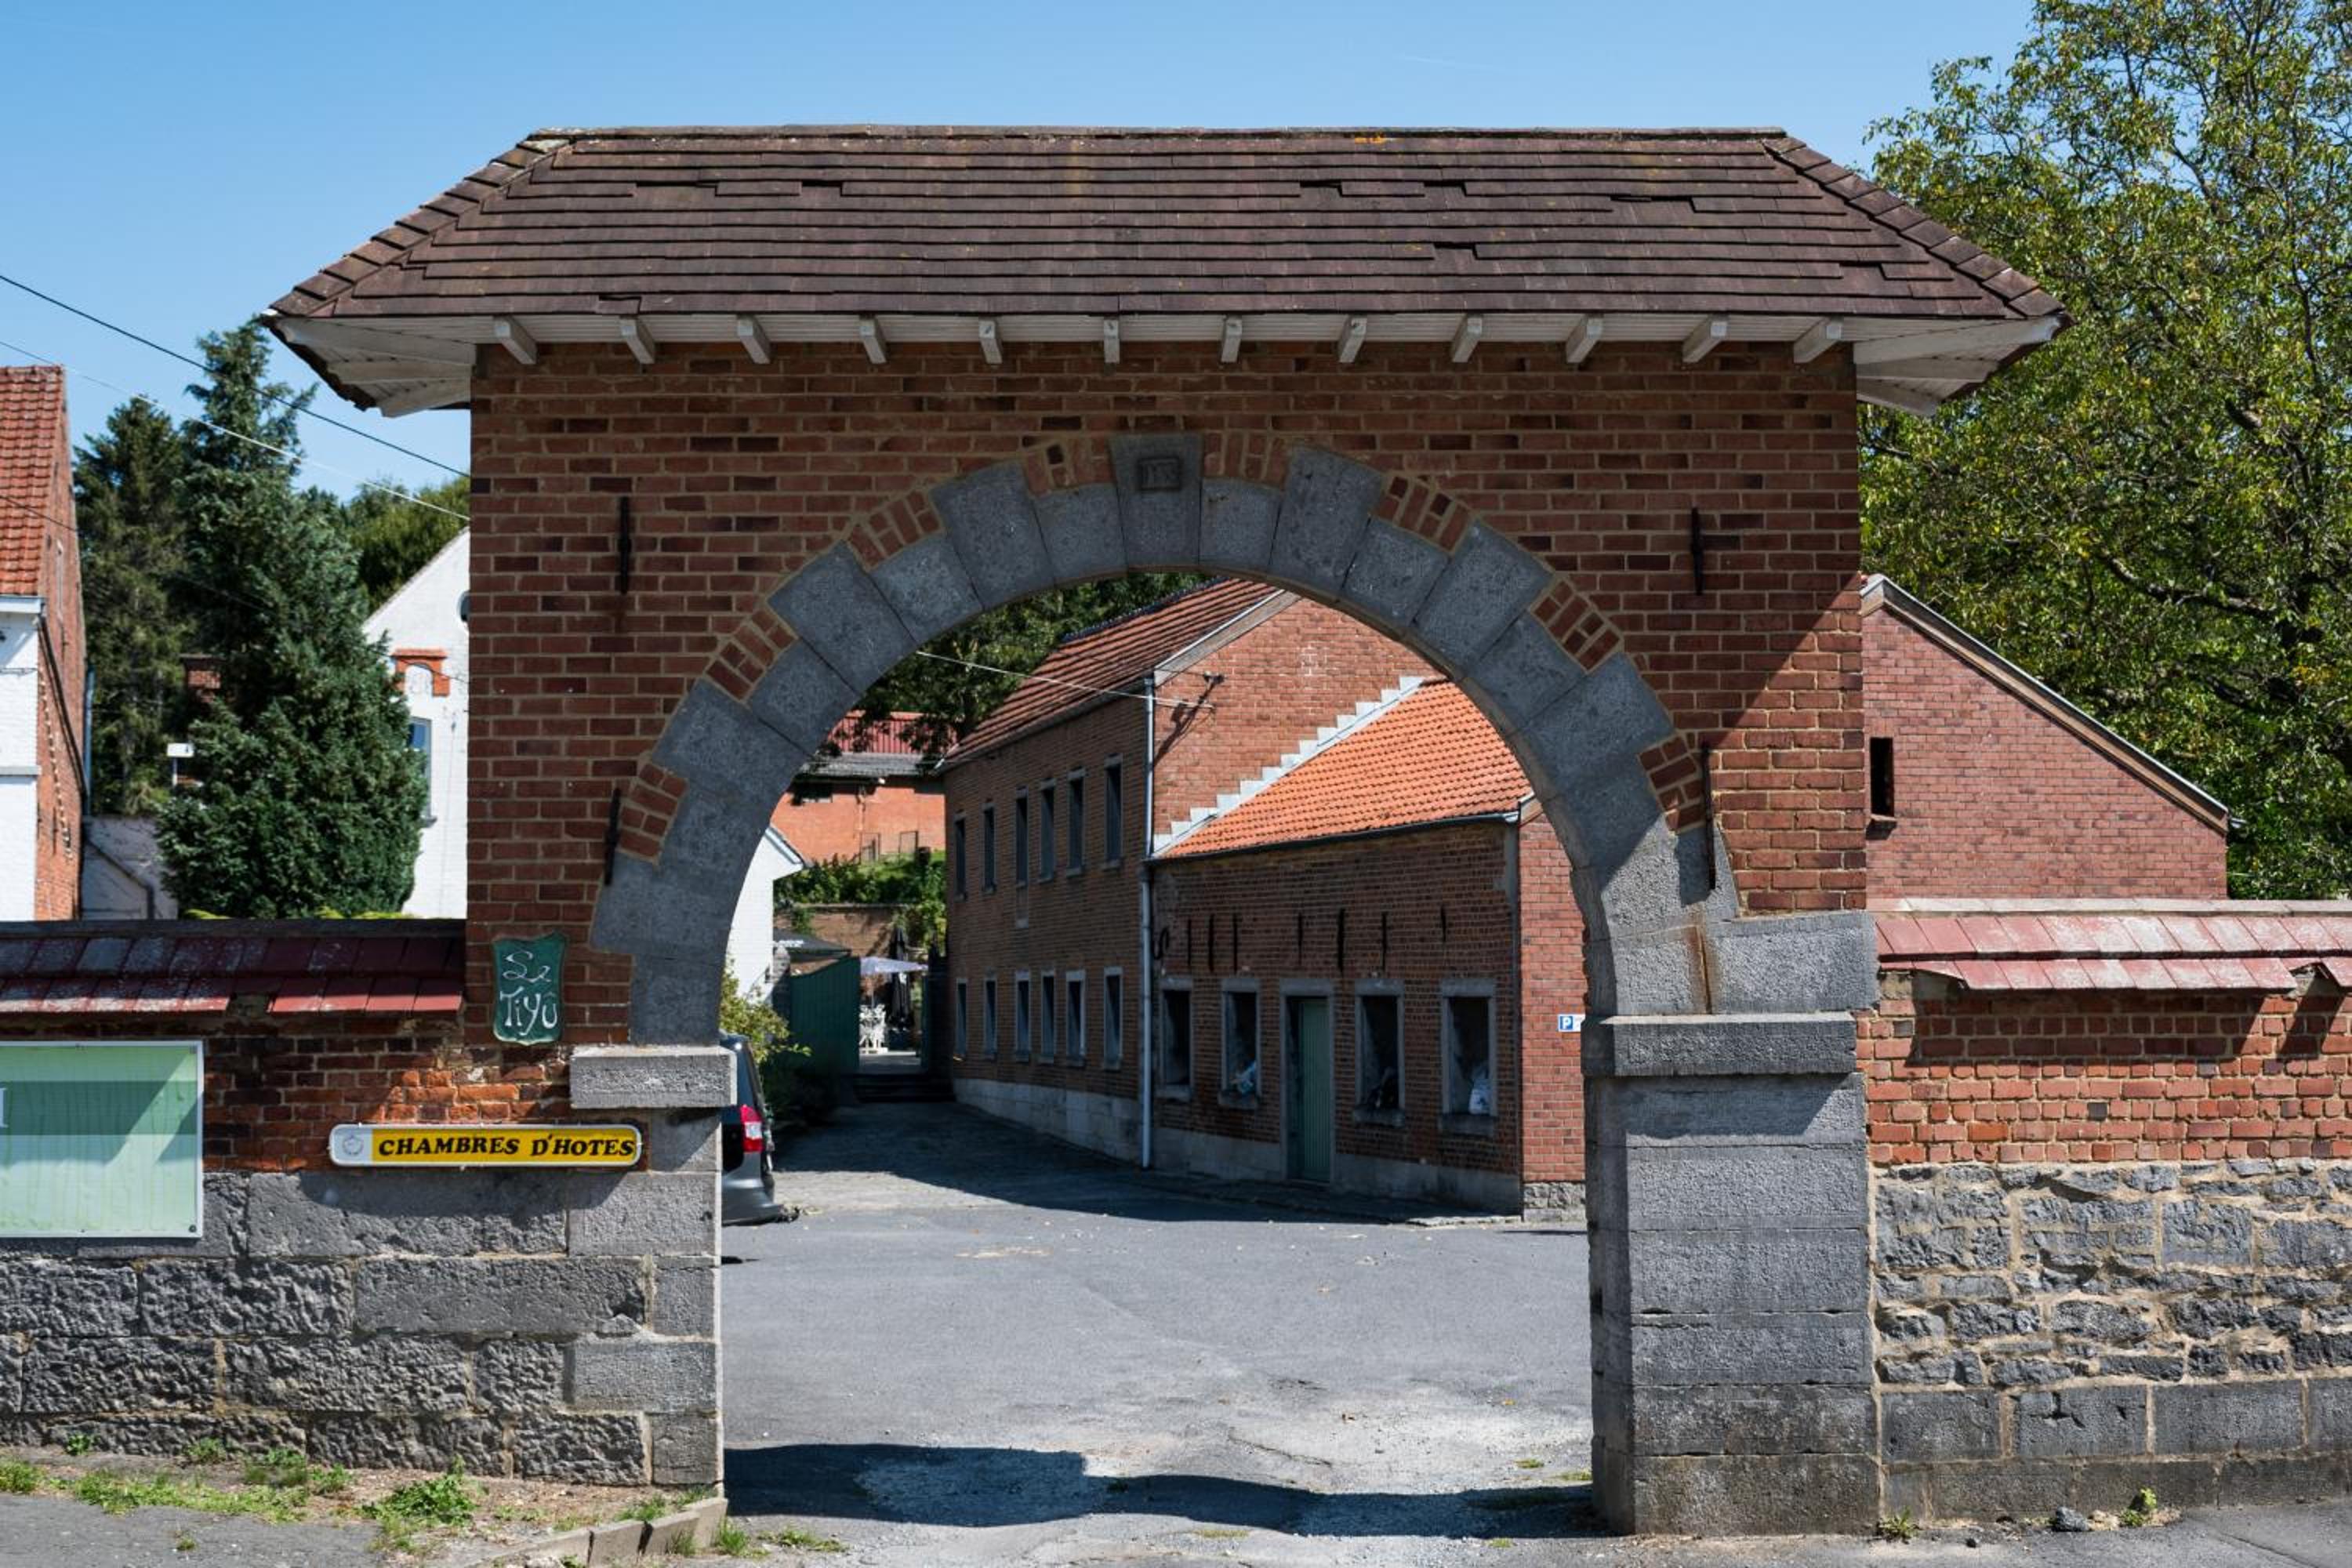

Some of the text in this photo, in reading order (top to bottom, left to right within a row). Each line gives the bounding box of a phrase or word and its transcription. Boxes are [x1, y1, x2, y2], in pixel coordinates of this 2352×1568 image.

[1562, 1016, 1572, 1029] P
[379, 1134, 635, 1156] CHAMBRES D'HOTES
